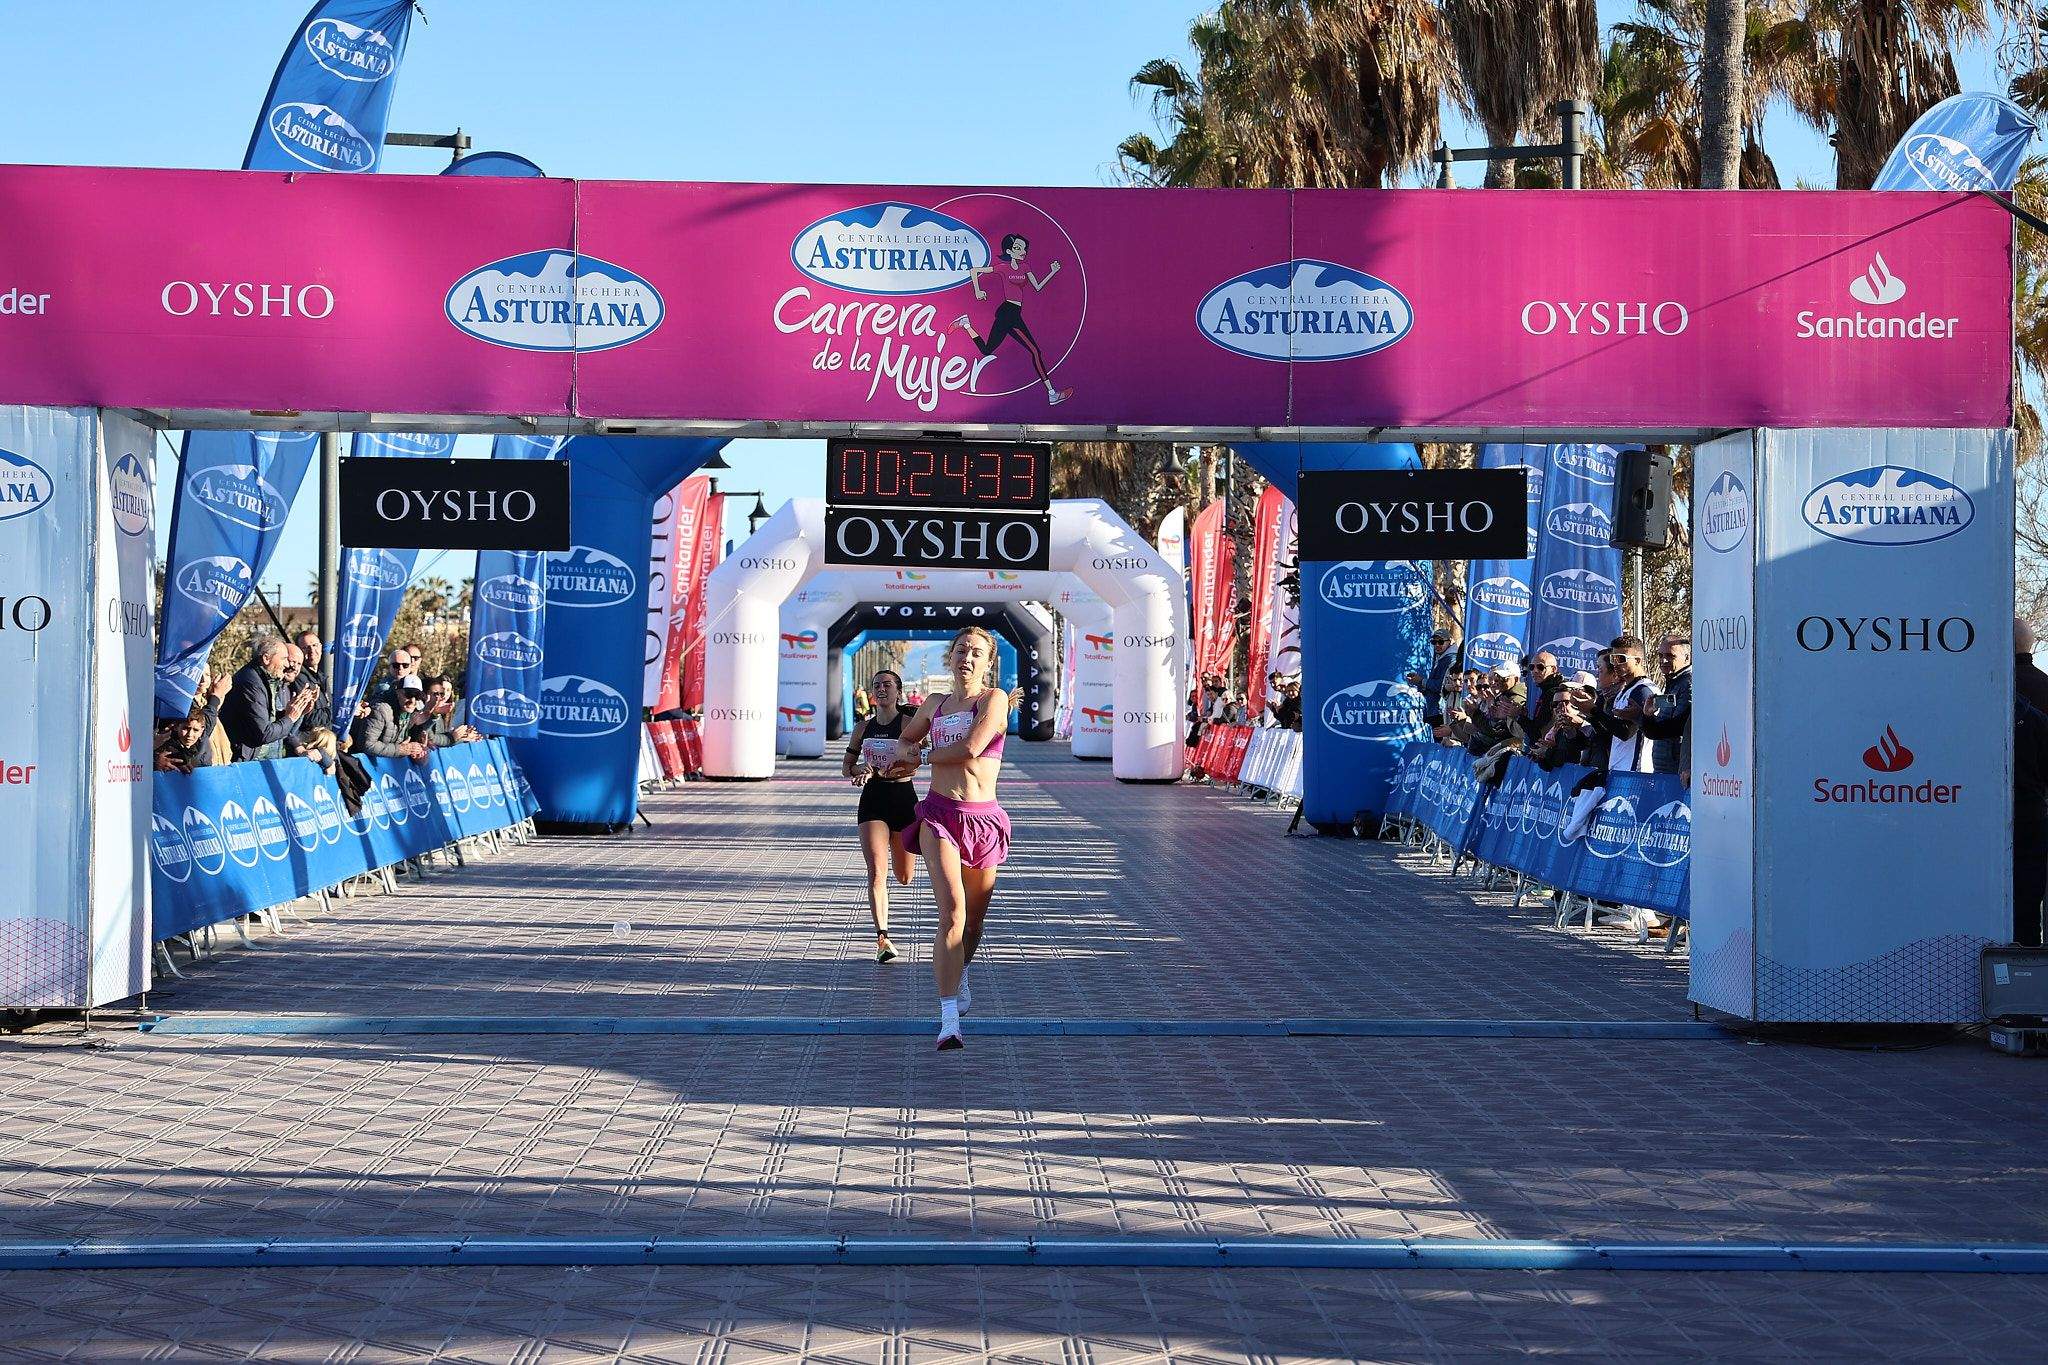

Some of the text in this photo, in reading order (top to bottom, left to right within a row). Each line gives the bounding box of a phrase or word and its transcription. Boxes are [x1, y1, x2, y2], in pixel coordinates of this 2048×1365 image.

[275, 111, 363, 168] ASTURIANA
[806, 234, 974, 272] ASTURIANA
[838, 233, 969, 244] CENTRAL LECHERA
[161, 280, 334, 319] OYSHO
[462, 285, 648, 327] ASTURIANA
[496, 284, 564, 294] CENTRAL
[1247, 295, 1390, 305] CENTRAL LECHERA
[773, 286, 938, 337] Carrera
[1213, 297, 1397, 335] ASTURIANA
[1521, 301, 1689, 336] OYSHO
[1797, 311, 1959, 339] Santander
[812, 331, 998, 413] de la Mujer
[842, 449, 1035, 500] 00:24:33
[376, 488, 537, 522] OYSHO
[1814, 495, 1962, 525] ASTURIANA
[1841, 493, 1956, 502] CENTRAL LECHERA
[1335, 500, 1494, 535] OYSHO
[672, 505, 694, 605] Santander
[836, 516, 1040, 562] OYSHO
[740, 557, 796, 570] OYSHO
[1092, 557, 1148, 571] OYSHO
[546, 574, 629, 595] STURIANA
[1543, 582, 1618, 605] ASTURIANA
[108, 598, 149, 638] OYSHO
[873, 606, 986, 617] VOLVO
[1123, 635, 1175, 648] OYSHO
[1700, 614, 1747, 653] OYSHO
[1796, 616, 1976, 652] OYSHO
[1030, 650, 1040, 729] VOLVO
[1702, 773, 1743, 798] Santander
[1814, 778, 1963, 803] Santander
